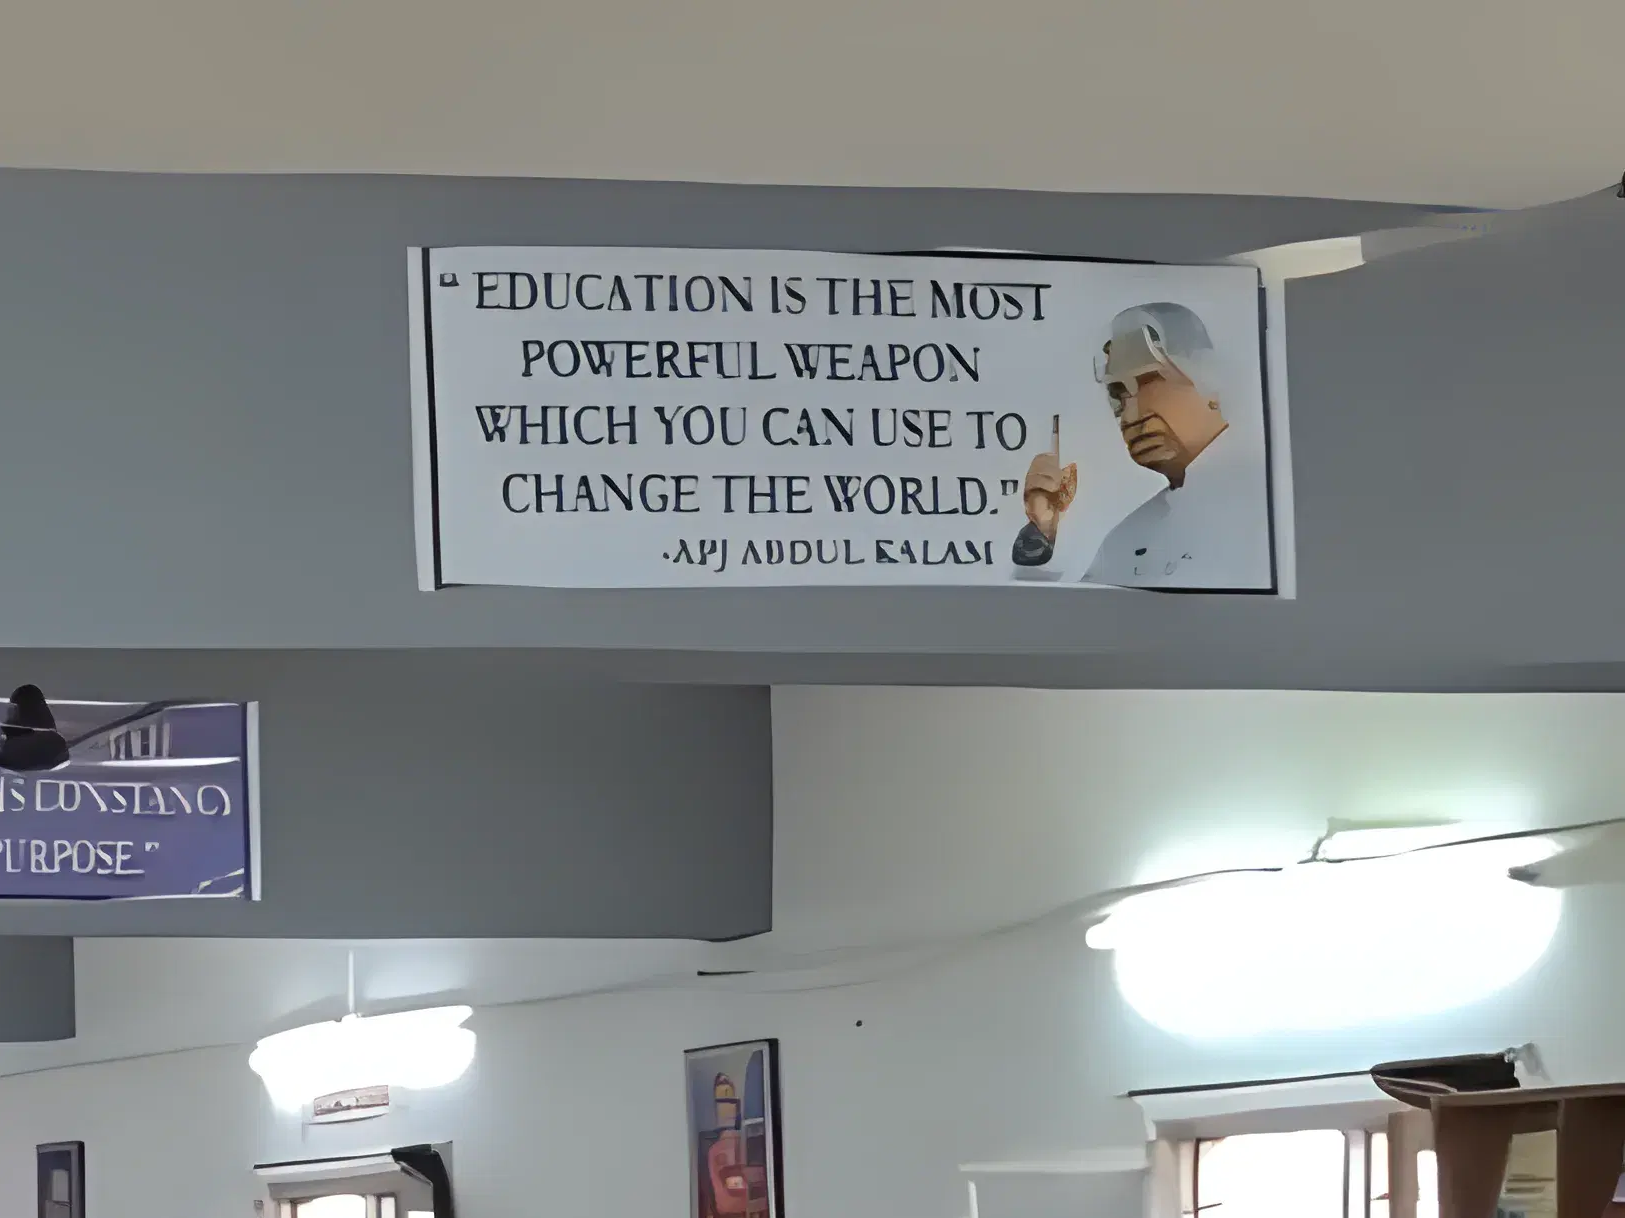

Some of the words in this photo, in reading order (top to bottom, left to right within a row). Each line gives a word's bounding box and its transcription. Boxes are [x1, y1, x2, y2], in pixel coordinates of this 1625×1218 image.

[473, 272, 753, 312] EDUCATION
[771, 276, 806, 314] IS
[819, 278, 916, 317] THE
[930, 282, 1051, 321] MOST
[522, 340, 777, 380] POWERFUL
[784, 343, 980, 382] WEAPON
[475, 405, 637, 445] WHICH
[654, 405, 746, 446] YOU
[763, 408, 854, 446] CAN
[872, 408, 952, 448] USE
[965, 411, 1026, 451] TO
[503, 474, 700, 513] CHANGE
[713, 475, 812, 514] THE
